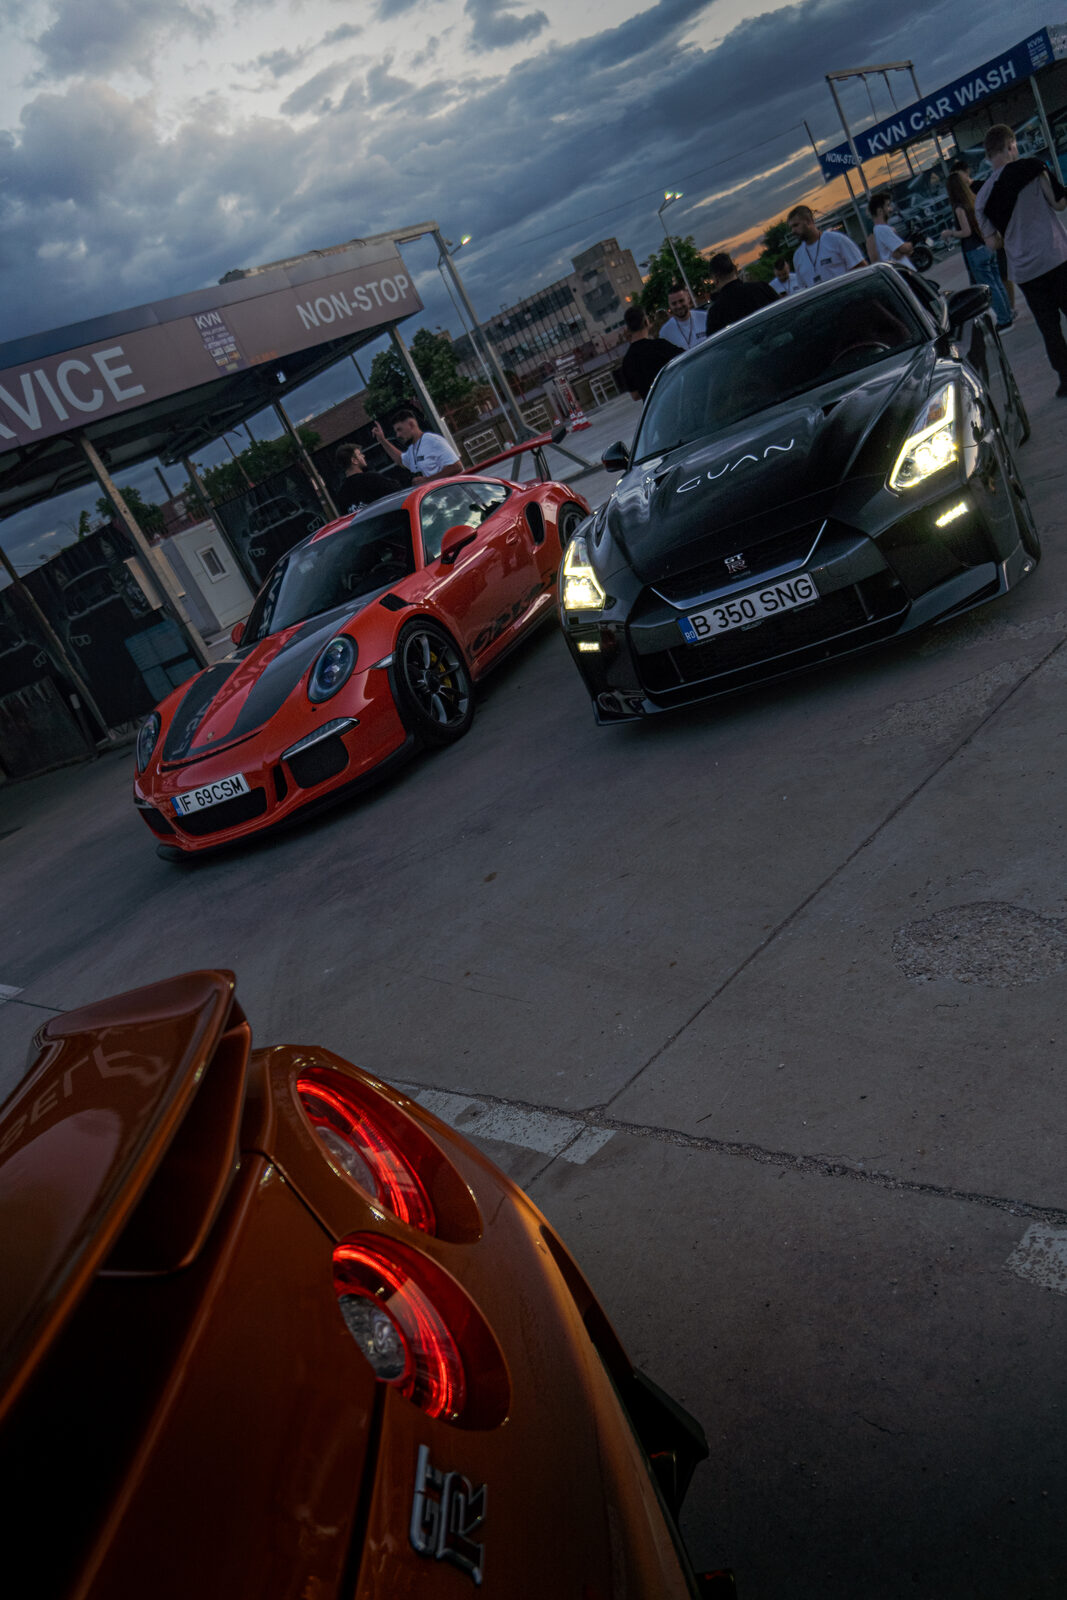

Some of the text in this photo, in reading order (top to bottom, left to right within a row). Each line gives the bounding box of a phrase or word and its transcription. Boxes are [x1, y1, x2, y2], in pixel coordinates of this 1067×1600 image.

[867, 60, 1017, 155] KVN CAR WASH
[194, 311, 222, 330] KVN
[296, 274, 409, 330] NON-STOP
[0, 346, 146, 440] VICE
[690, 578, 813, 637] B 350 SNG
[179, 795, 191, 812] IF
